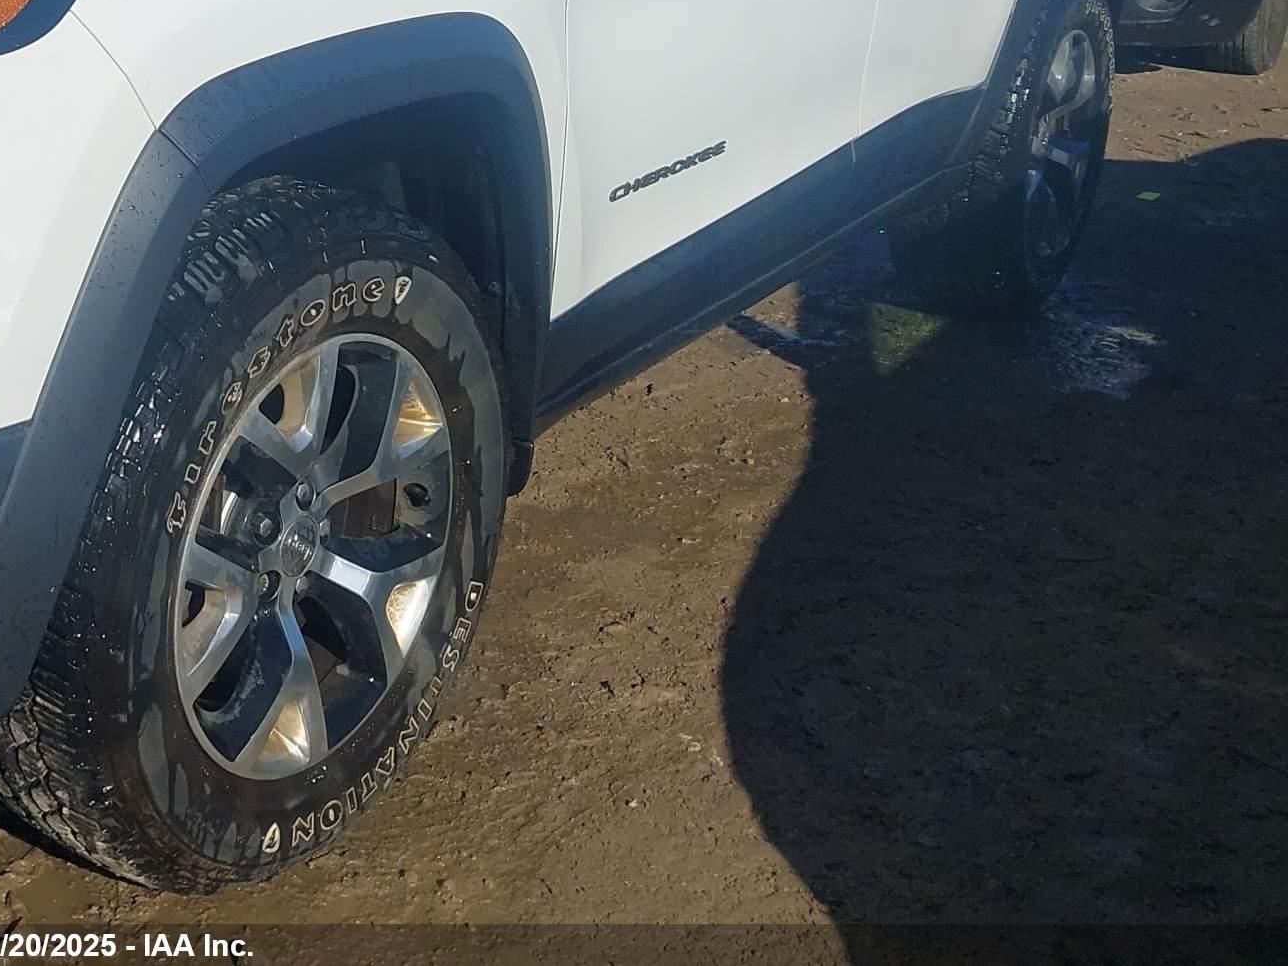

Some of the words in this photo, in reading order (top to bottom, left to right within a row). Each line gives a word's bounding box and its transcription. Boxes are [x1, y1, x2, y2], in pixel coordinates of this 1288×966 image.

[608, 140, 728, 203] CHEROKEE
[166, 276, 386, 534] Firestone
[291, 580, 484, 847] DESTINATION
